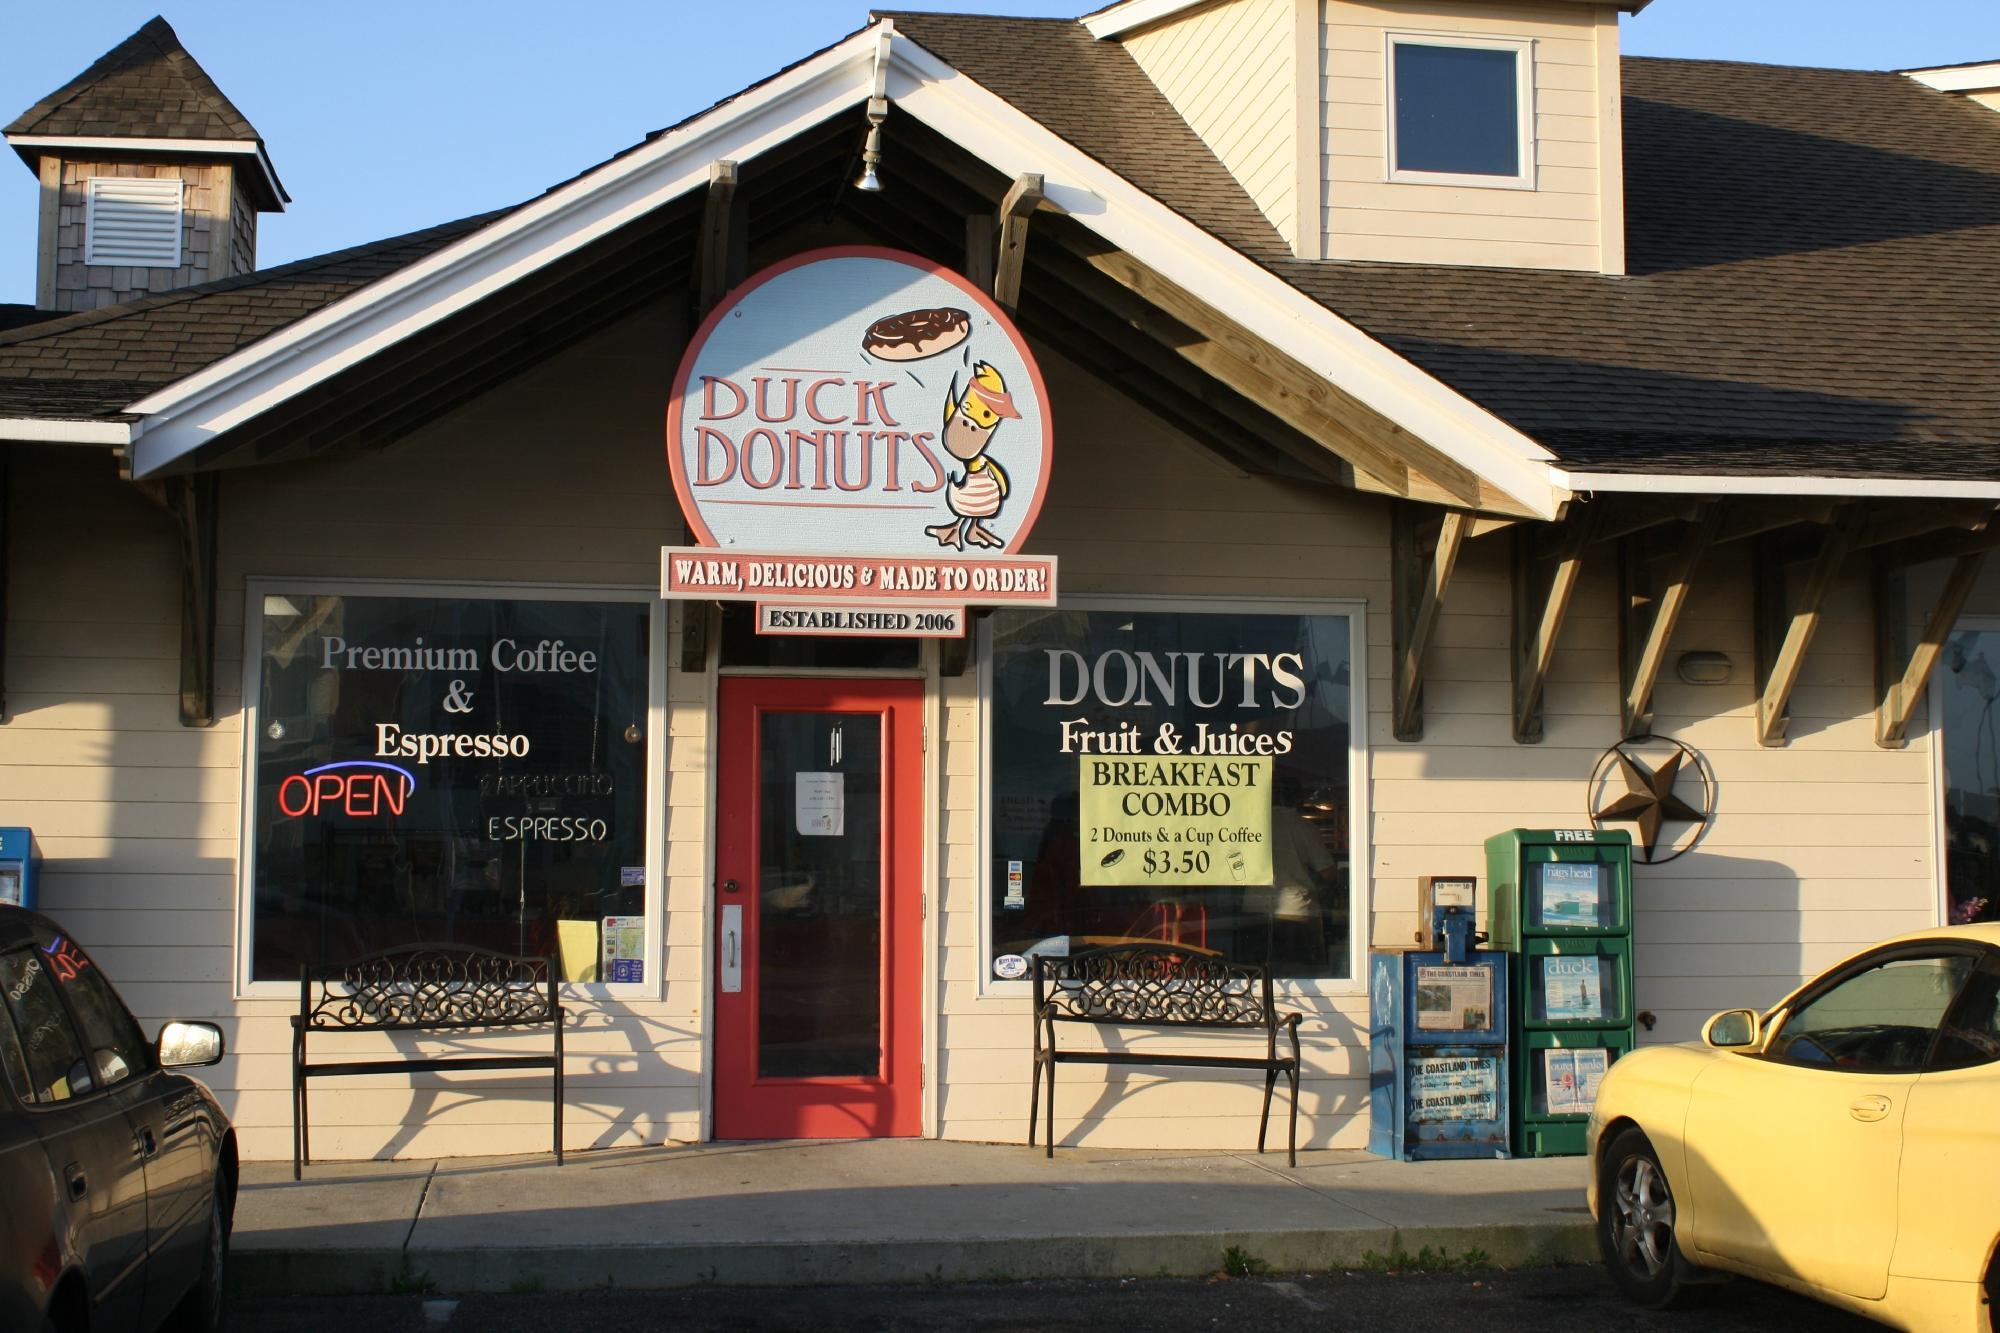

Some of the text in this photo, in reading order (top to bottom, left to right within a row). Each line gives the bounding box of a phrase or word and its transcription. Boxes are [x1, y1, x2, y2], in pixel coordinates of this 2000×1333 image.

[699, 375, 900, 426] DUCK
[693, 426, 946, 493] DONUTS
[675, 560, 1048, 593] WARM, DELICIOUS & MADE TO ORDER!
[769, 610, 956, 632] ESTABLISHED 2006
[320, 636, 597, 673] Premium Coffee
[1043, 648, 1306, 709] DONUTS
[443, 679, 474, 713] &
[375, 723, 530, 764] Espresso
[1060, 717, 1294, 756] Fruit & Juices
[1092, 761, 1261, 788] BREAKFAST
[279, 774, 406, 817] OPEN
[1121, 791, 1232, 817] COMBO
[489, 816, 607, 841] ESPRESSO
[1090, 826, 1263, 846] 2 Donuts & a Cup Coffee
[1553, 830, 1595, 842] FREE
[1142, 848, 1211, 878] $3.50
[1570, 866, 1593, 879] head
[1548, 957, 1594, 975] duck
[1411, 1059, 1491, 1076] THE COASTLAND TIMES
[1411, 1093, 1491, 1110] THE COASTLAND TIMES
